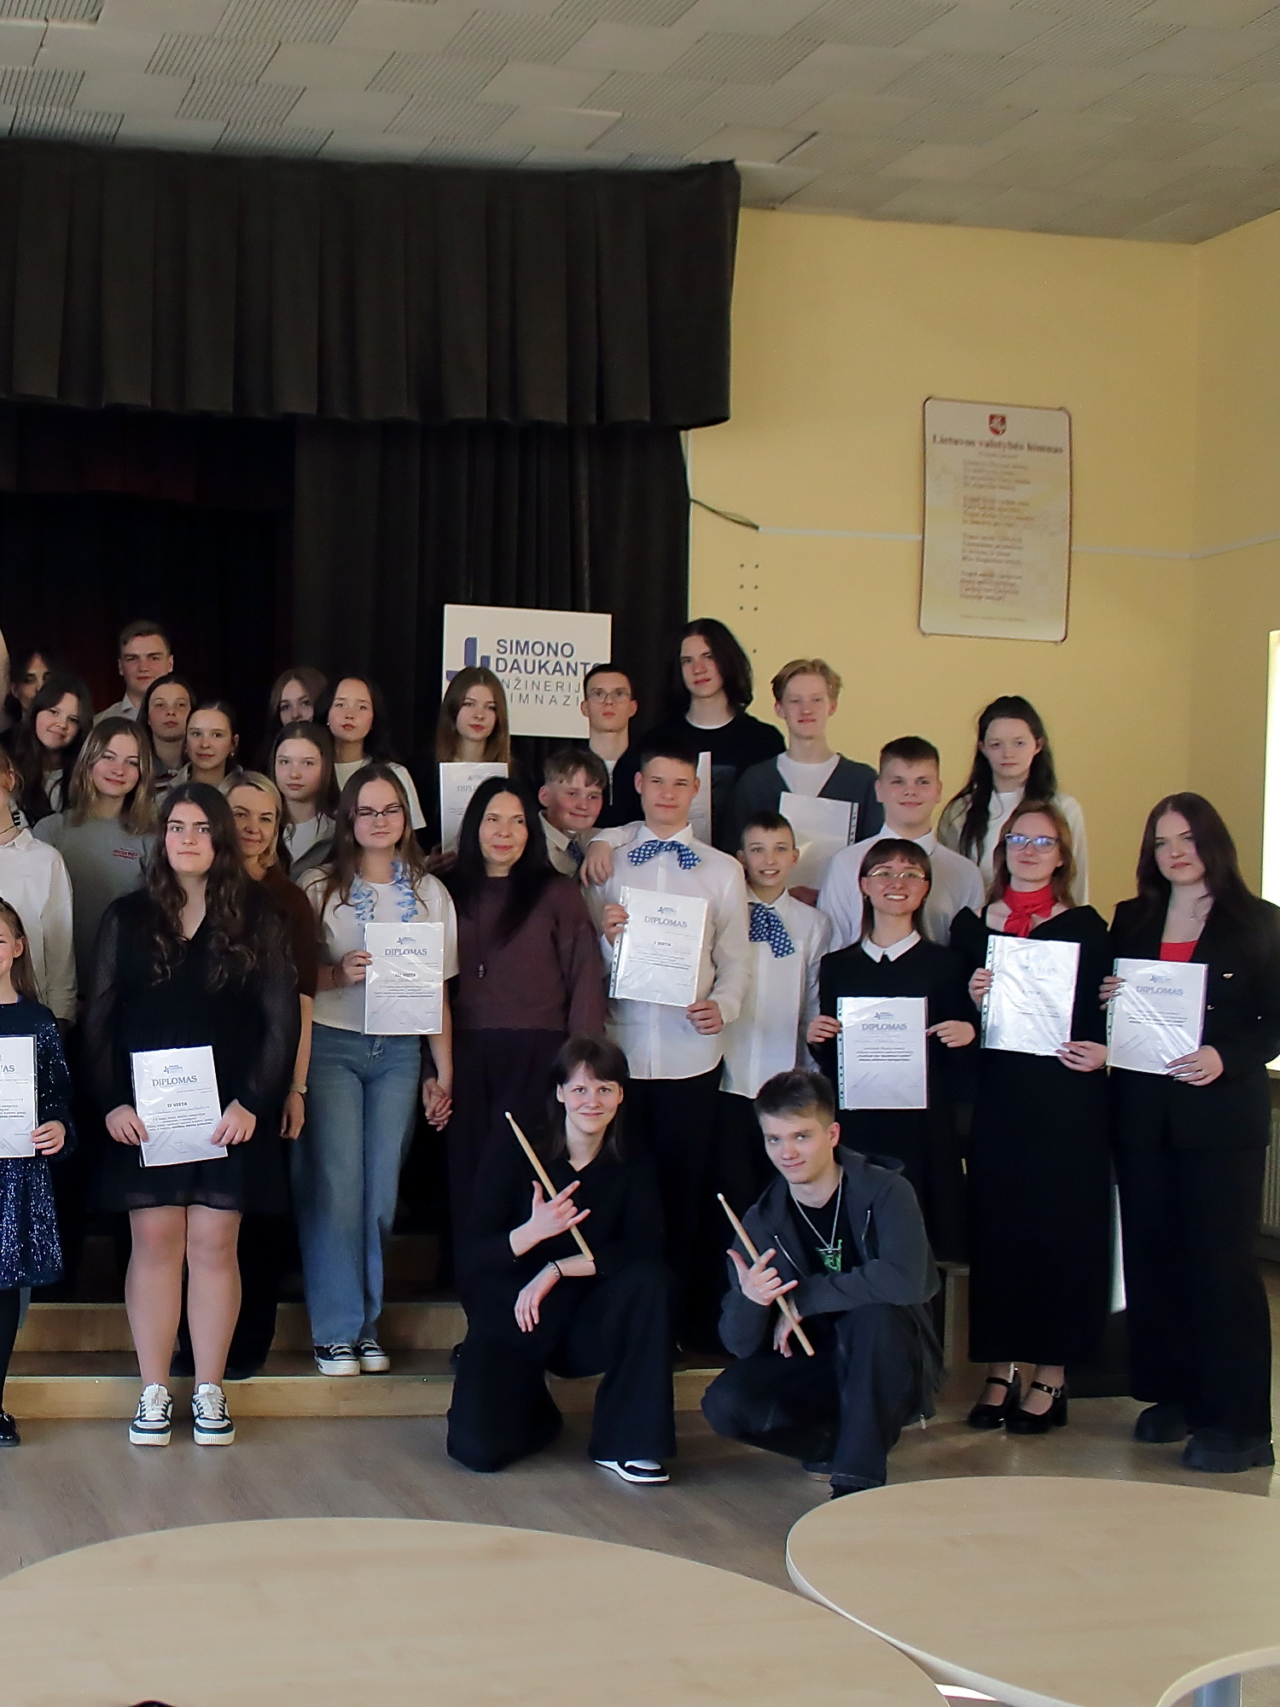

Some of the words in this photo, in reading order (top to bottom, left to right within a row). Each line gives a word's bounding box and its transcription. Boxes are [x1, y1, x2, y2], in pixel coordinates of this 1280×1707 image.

[496, 638, 575, 659] SIMONO
[500, 677, 582, 694] NŽINERIJ
[509, 692, 580, 707] IMNAZI
[644, 915, 688, 929] DIPLOMAS
[384, 948, 428, 956] DIPLOMAS
[1135, 985, 1184, 996] DIPLOMAS
[861, 1023, 907, 1031] DIPLOMAS
[152, 1075, 198, 1087] DIPLOMAS
